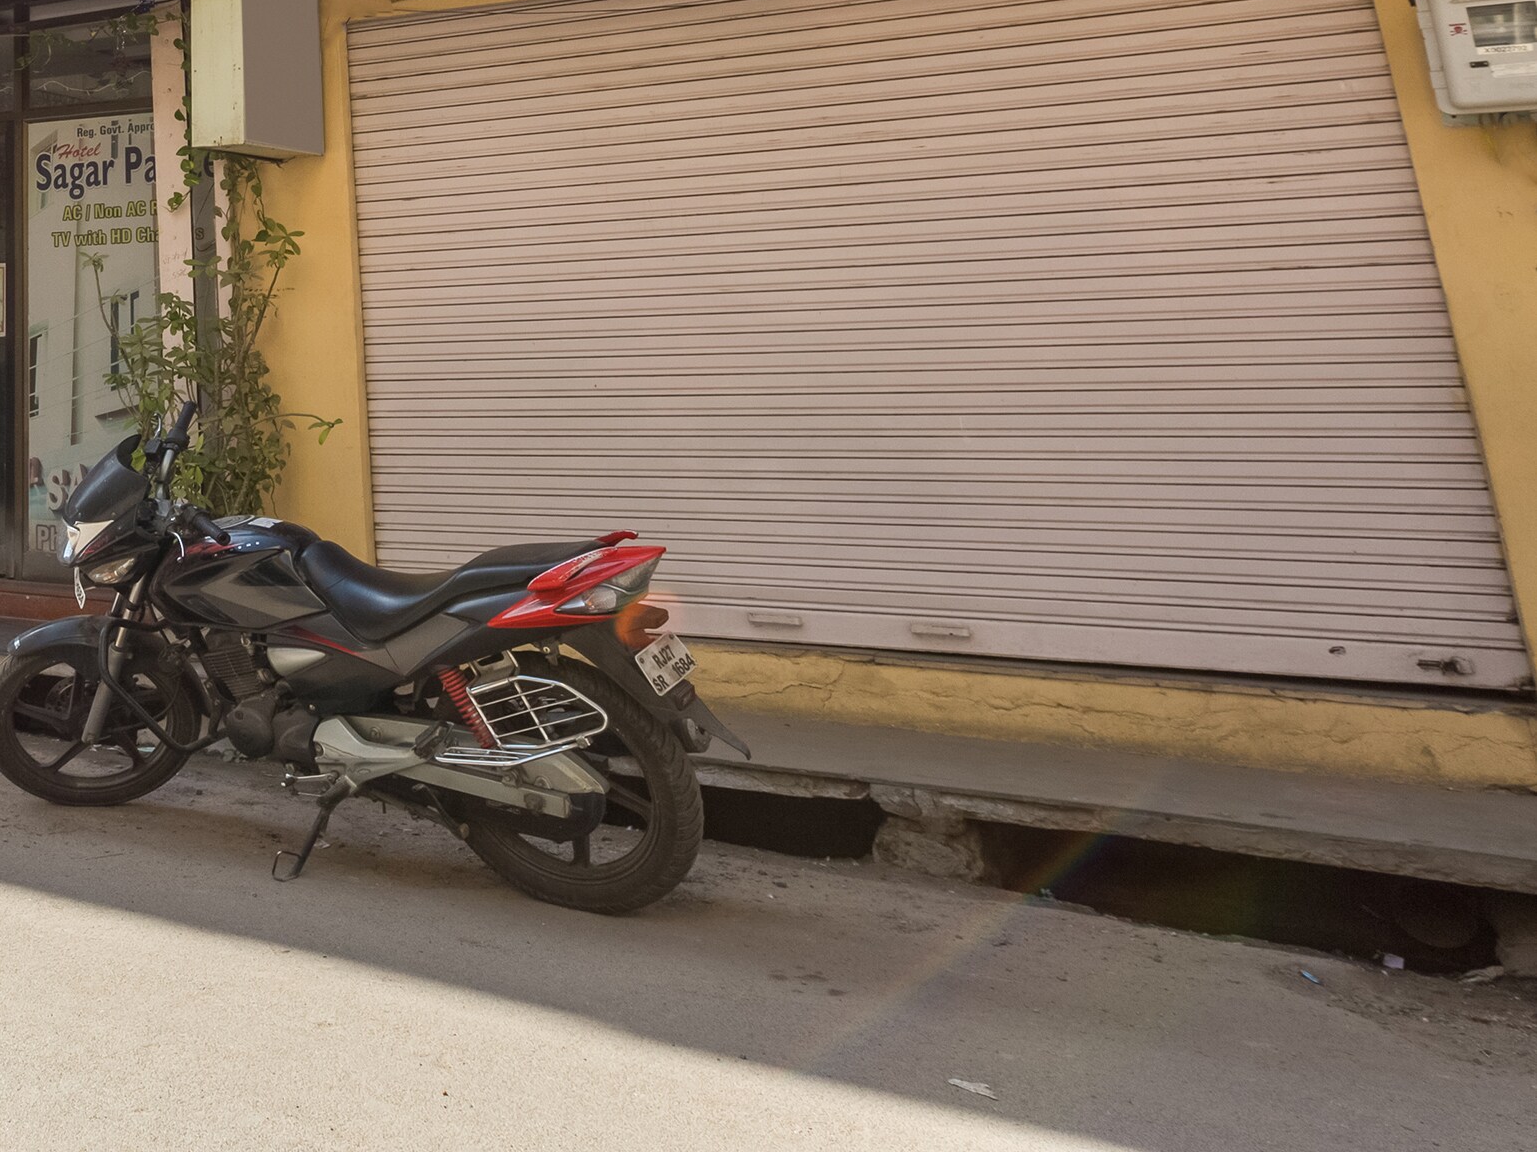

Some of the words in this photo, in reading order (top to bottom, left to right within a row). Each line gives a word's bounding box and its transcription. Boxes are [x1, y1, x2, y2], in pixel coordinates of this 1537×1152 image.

[76, 127, 97, 138] Reg.
[99, 124, 124, 136] Govt.
[54, 143, 102, 160] Hotel
[36, 152, 116, 200] Sagar
[62, 204, 82, 221] AC
[93, 203, 122, 219] Non
[126, 201, 146, 217] AC
[51, 231, 71, 248] TV
[74, 230, 106, 247] with
[110, 228, 132, 245] HD
[652, 644, 676, 670] RJ27
[652, 674, 670, 693] SR
[671, 653, 696, 678] 1684
